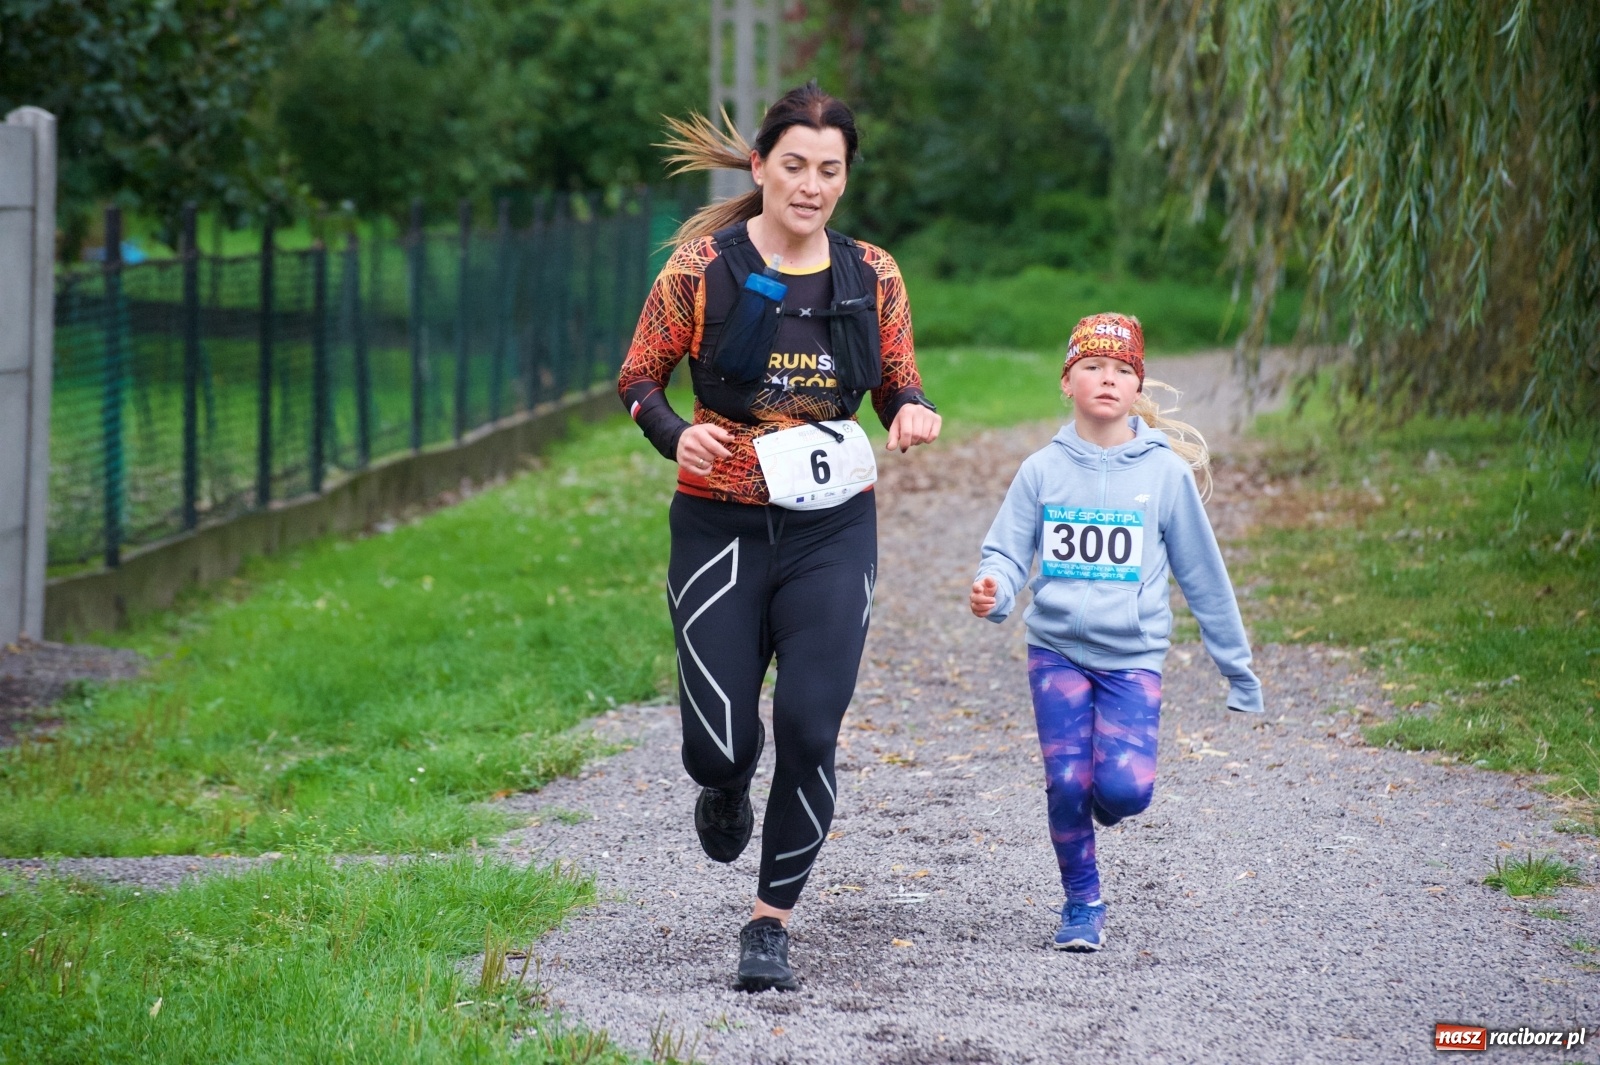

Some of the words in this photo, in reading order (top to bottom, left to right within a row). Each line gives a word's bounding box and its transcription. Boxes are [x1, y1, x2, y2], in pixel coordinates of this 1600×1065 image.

[768, 352, 836, 371] RUNS
[810, 449, 831, 485] 6
[1134, 493, 1151, 503] 4F
[1047, 509, 1140, 524] TIME-SPORT.PL
[1052, 523, 1132, 565] 300
